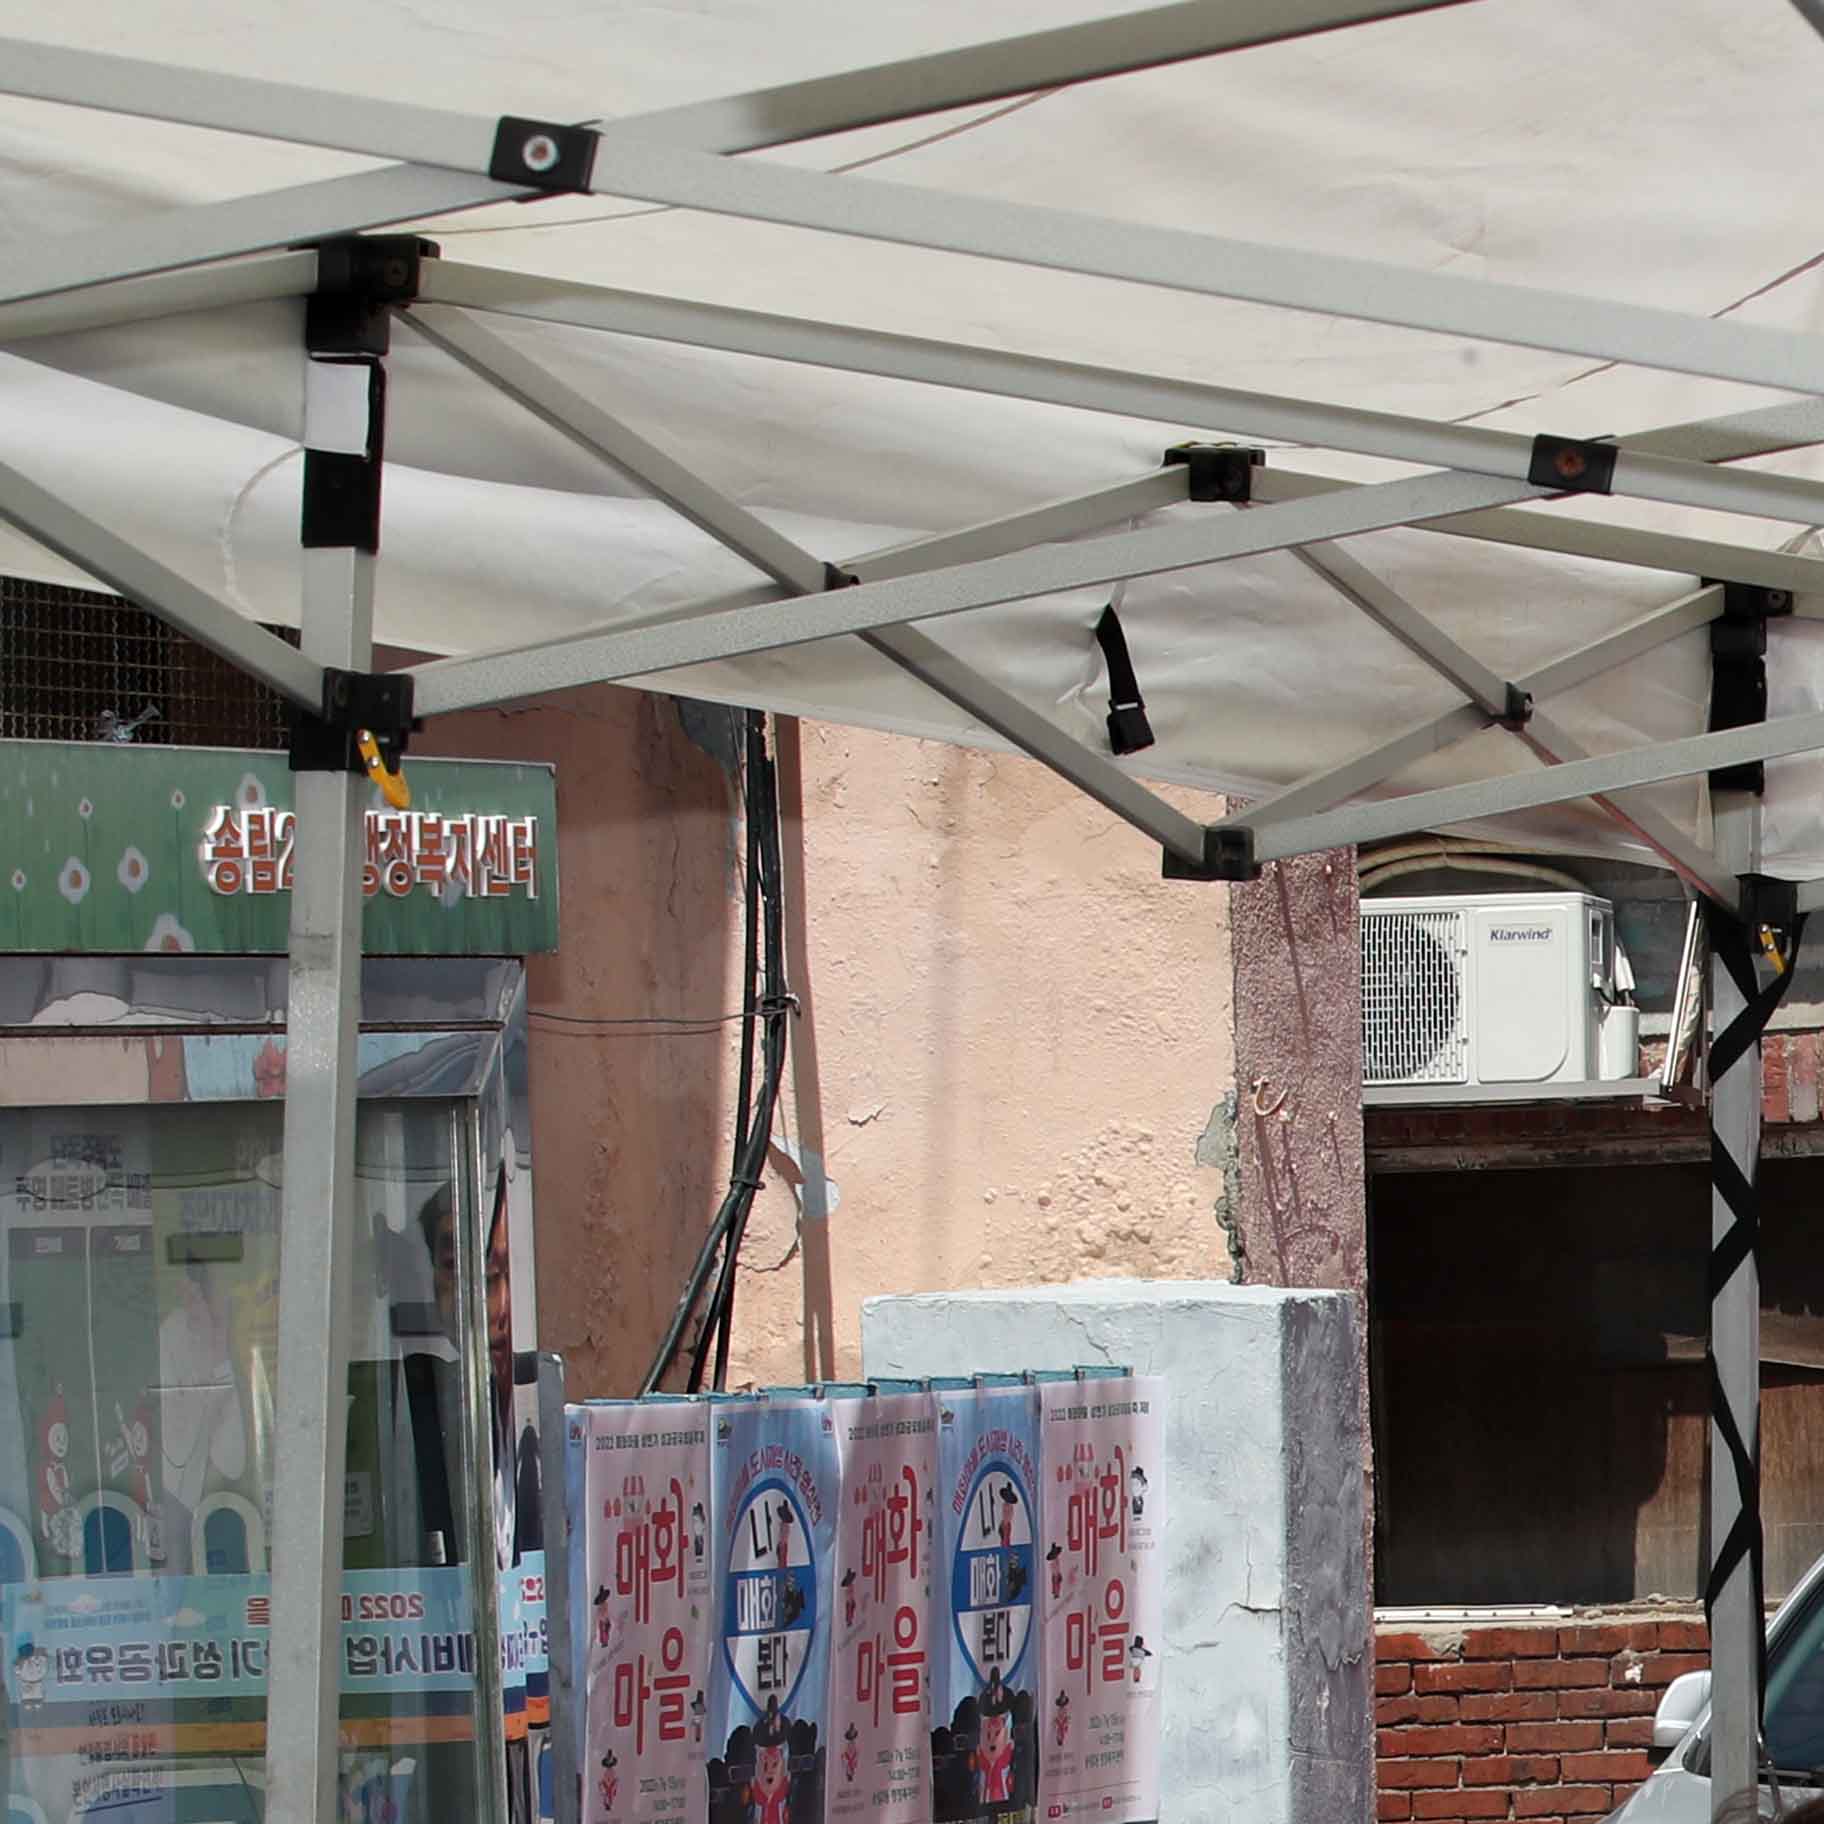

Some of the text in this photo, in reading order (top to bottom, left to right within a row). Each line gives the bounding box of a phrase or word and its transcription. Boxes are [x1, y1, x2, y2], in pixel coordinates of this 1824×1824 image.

[203, 806, 297, 895] 송림2
[1490, 927, 1552, 942] Klarwind
[615, 1476, 689, 1625] 매화
[748, 1500, 775, 1560] 나
[861, 1463, 923, 1607] 매화
[978, 1490, 998, 1539] 나
[1067, 1445, 1128, 1582] 매화
[735, 1574, 778, 1634] 매화
[969, 1555, 1000, 1609] 매화
[755, 1636, 790, 1693] 본다
[855, 1604, 926, 1729] 마을
[980, 1610, 1013, 1666] 본다
[1064, 1578, 1130, 1697] 마을
[613, 1626, 690, 1755] 마을
